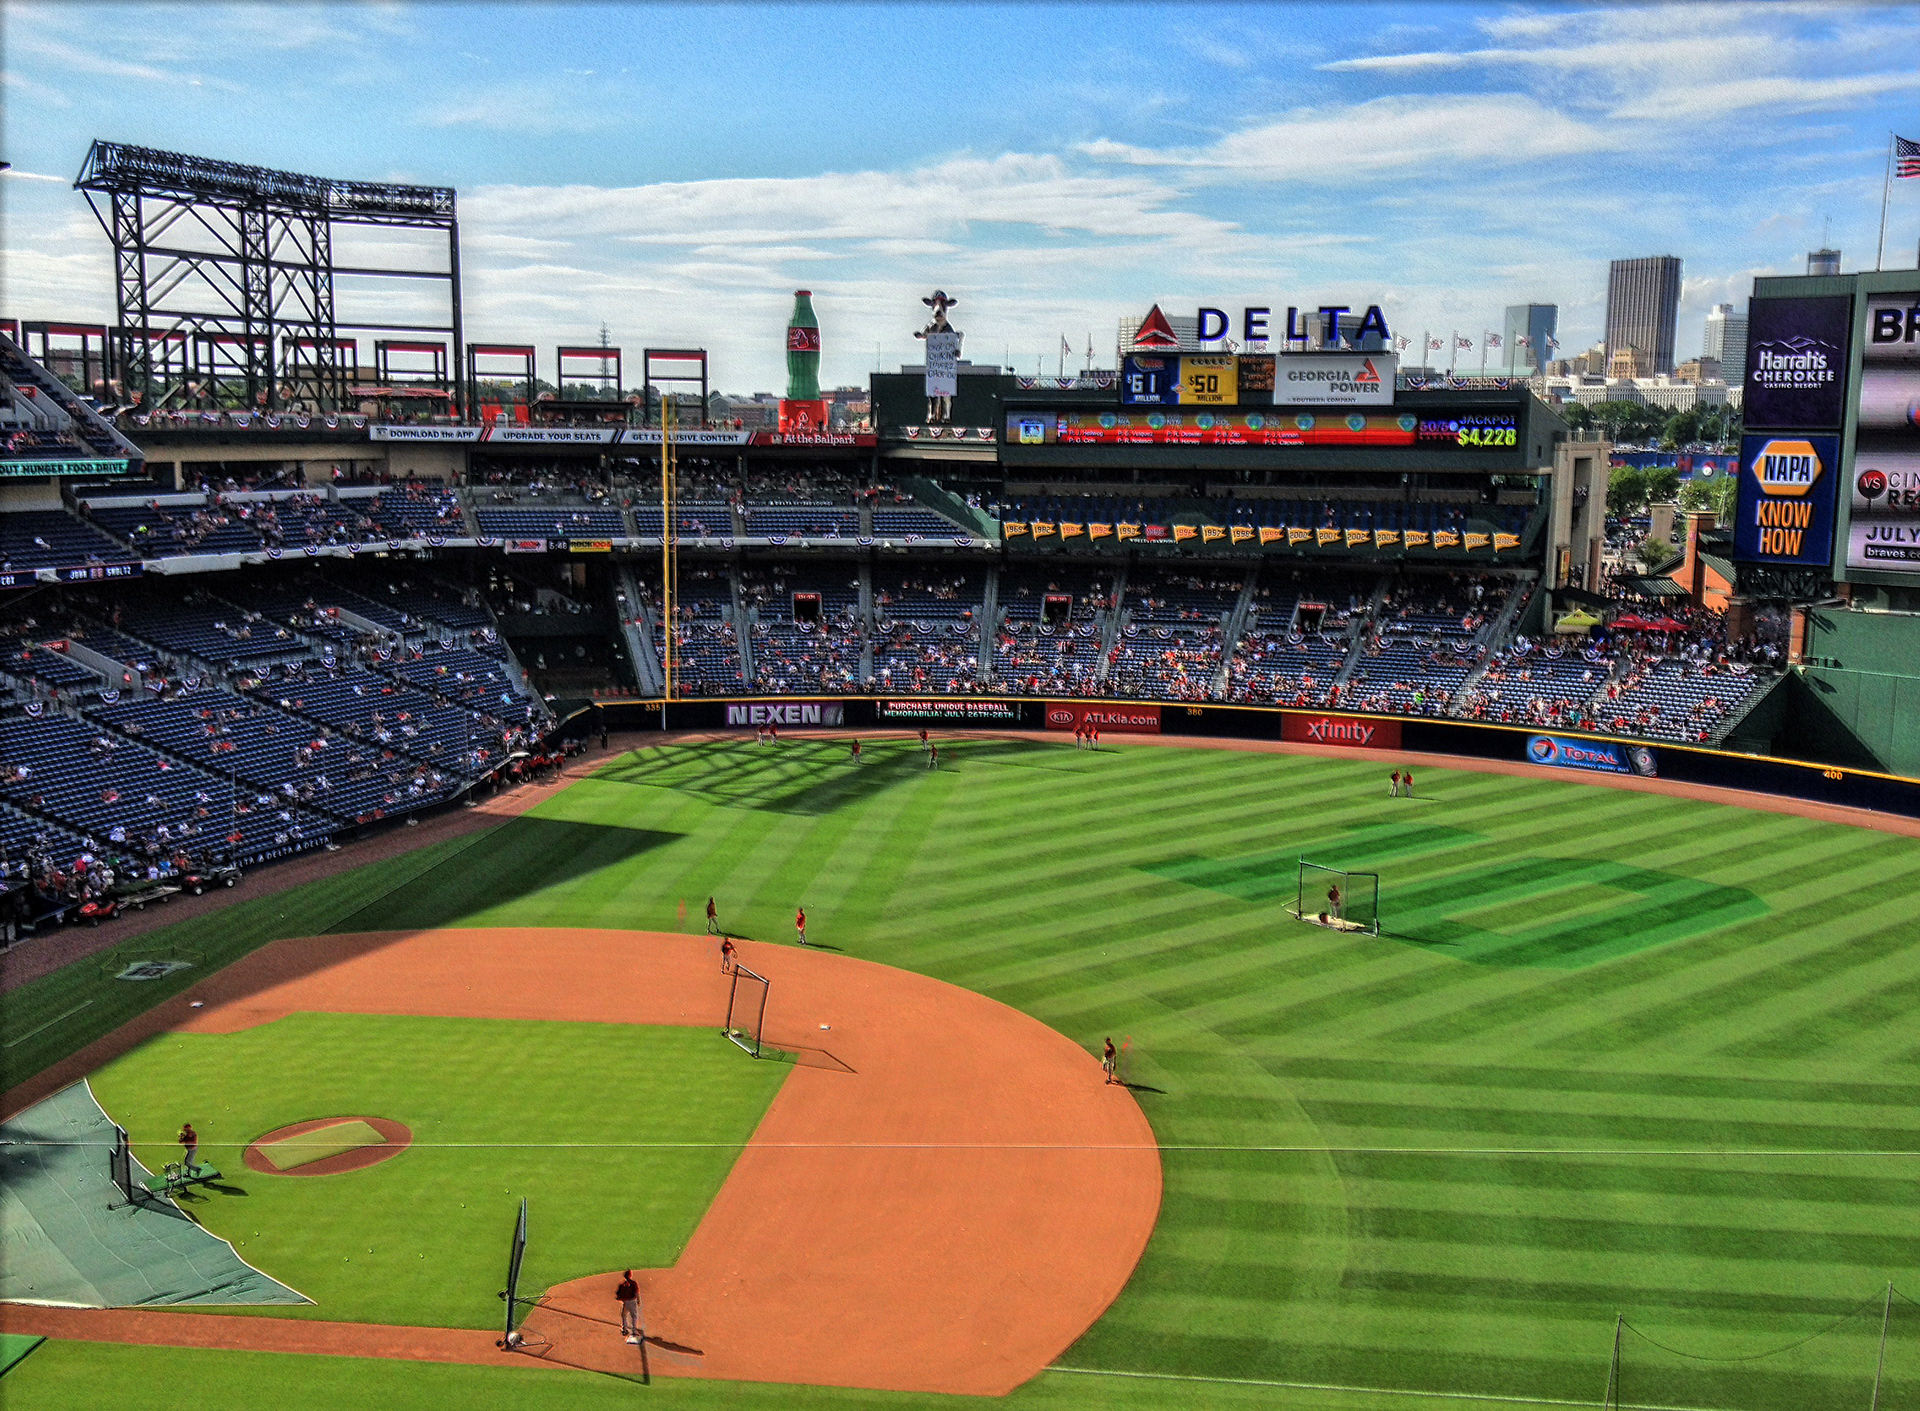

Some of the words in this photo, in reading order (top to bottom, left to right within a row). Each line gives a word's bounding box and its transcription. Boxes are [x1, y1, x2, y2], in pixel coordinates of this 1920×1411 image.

[1198, 306, 1391, 342] DELTA
[1760, 351, 1828, 370] Harrah's
[1288, 370, 1351, 382] GEORGIA
[1753, 370, 1835, 382] CHEROKEE
[1127, 373, 1158, 394] $61
[1189, 375, 1219, 394] $50
[1330, 382, 1380, 394] POWER
[1134, 395, 1161, 403] MILLION
[1196, 395, 1224, 403] MILLION
[1460, 414, 1517, 426] JACKPOT
[390, 430, 440, 439] DOWNLOAD
[442, 431, 455, 439] the
[457, 431, 475, 439] APP
[503, 432, 546, 441] UPGRADE
[550, 432, 573, 441] YOUR
[574, 433, 602, 441] SEATS
[632, 434, 650, 442] GET
[651, 434, 699, 443] EXLUSIVE
[700, 434, 740, 443] CONTENT
[784, 434, 797, 444] At
[798, 434, 814, 445] the
[815, 434, 856, 445] Ballpark
[1458, 427, 1517, 448] $4,228
[22, 464, 64, 474] HUNGER
[66, 463, 94, 474] FOOD
[95, 463, 125, 473] DRIVE
[1764, 456, 1811, 482] NAPA
[1864, 476, 1881, 489] VS
[1756, 500, 1812, 528] KNOW
[1759, 528, 1803, 555] HOW
[645, 703, 661, 712] 335
[889, 702, 933, 711] PURCHASE
[934, 702, 966, 711] UNIQUE
[966, 702, 1009, 712] BASEBALL
[1187, 708, 1203, 716] 380
[728, 705, 821, 725] NEXEN
[1084, 712, 1158, 726] ATLKia.com
[1307, 718, 1375, 745] xfinity
[1561, 746, 1619, 765] TOTAL
[1823, 770, 1843, 781] 400
[304, 836, 330, 850] DELTA
[265, 845, 294, 860] DELTA
